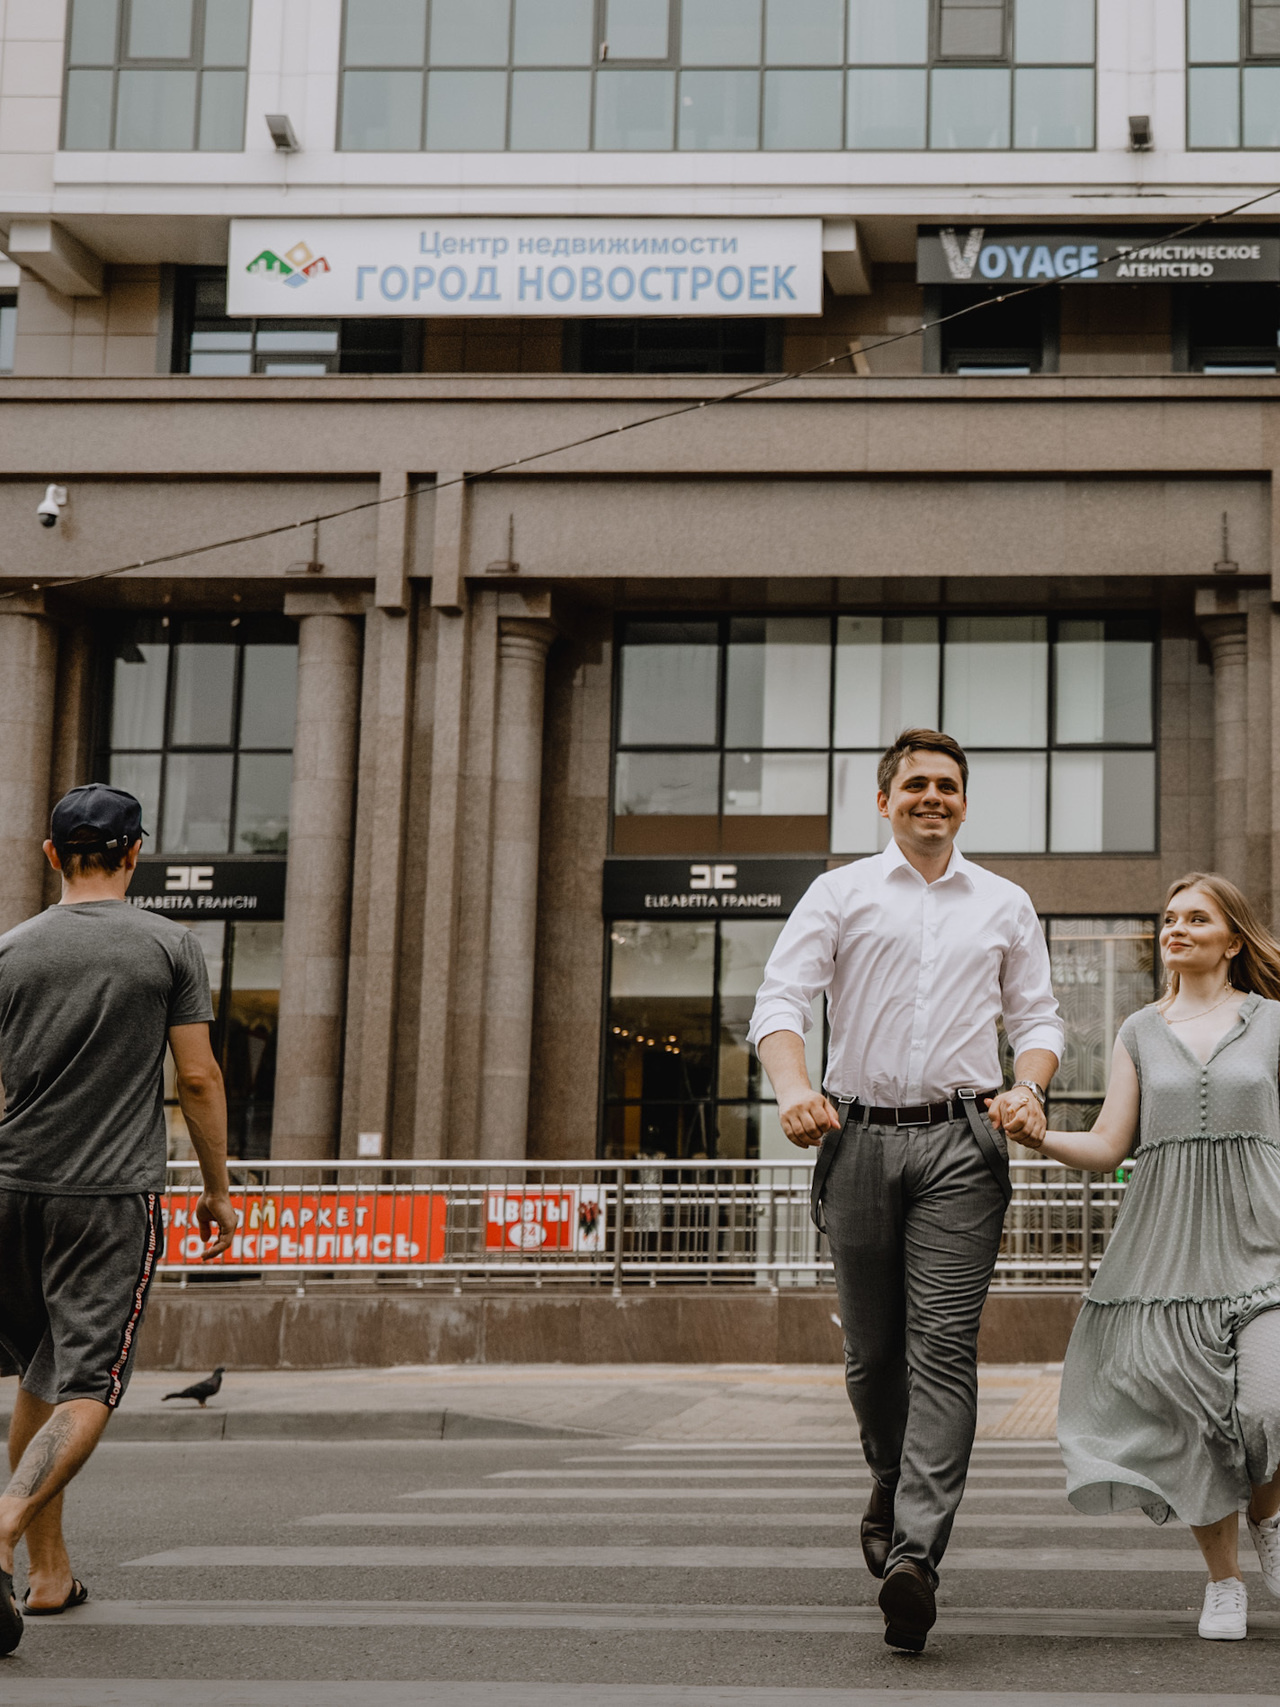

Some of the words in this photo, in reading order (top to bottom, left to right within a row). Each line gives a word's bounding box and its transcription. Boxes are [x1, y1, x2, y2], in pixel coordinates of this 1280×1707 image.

[419, 231, 509, 257] Центр
[518, 235, 738, 256] недвижимости
[939, 228, 1099, 279] VOYAGE
[1116, 245, 1261, 261] ТУРИСТИЧЕСКОЕ
[1116, 263, 1214, 278] АГЕНТСТВО
[355, 265, 502, 302] ГОРОД
[518, 264, 798, 301] НОВОСТРОЕК
[126, 895, 194, 909] LISABETTA
[197, 896, 258, 909] FRANCHI
[644, 894, 718, 908] ELISABETTA
[721, 894, 782, 908] FRANCHI
[487, 1196, 569, 1227] Цветы
